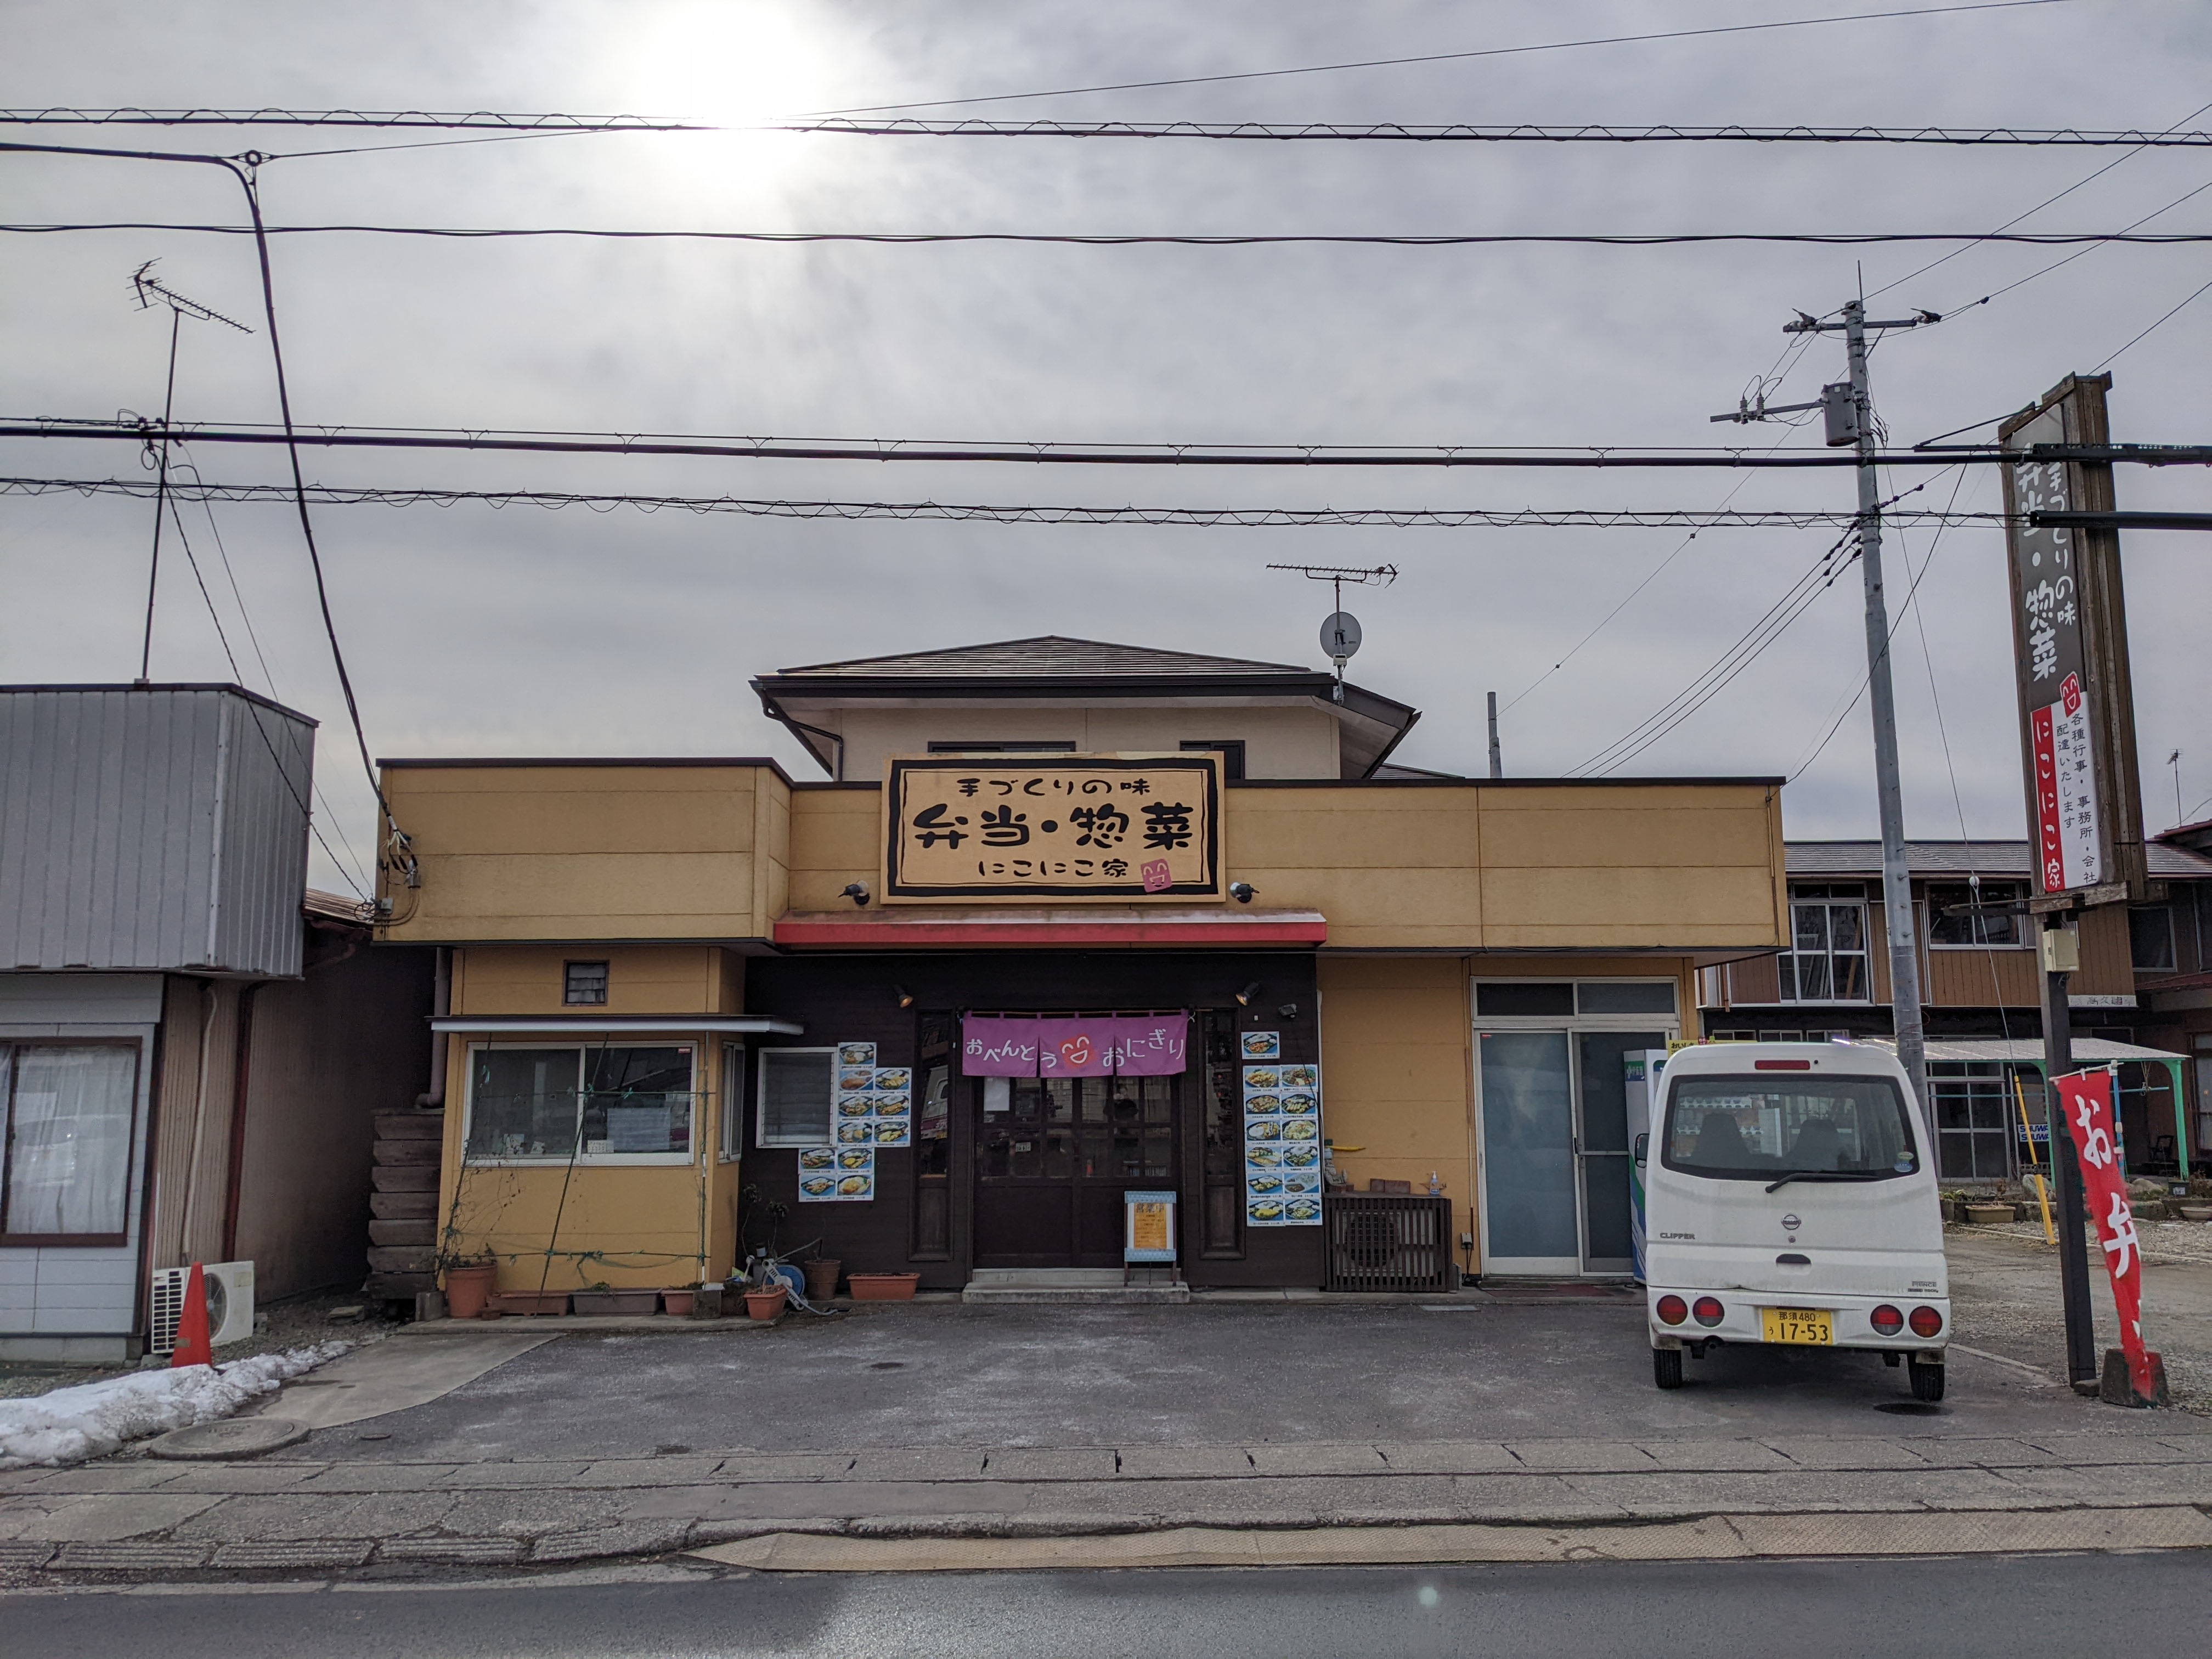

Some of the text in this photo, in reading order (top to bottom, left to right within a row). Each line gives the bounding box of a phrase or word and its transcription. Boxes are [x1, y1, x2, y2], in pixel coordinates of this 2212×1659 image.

[957, 778, 1150, 797] 手づくりの味
[2056, 724, 2075, 828] 配達いたします
[913, 802, 1194, 850] 弁当・惣菜
[2036, 720, 2061, 889] にこにこ家
[979, 858, 1129, 878] にこにこ家
[966, 1028, 1185, 1068] おべんとう おにぎり
[2075, 1094, 2141, 1339] お弁
[1769, 1323, 1829, 1342] う 17-53
